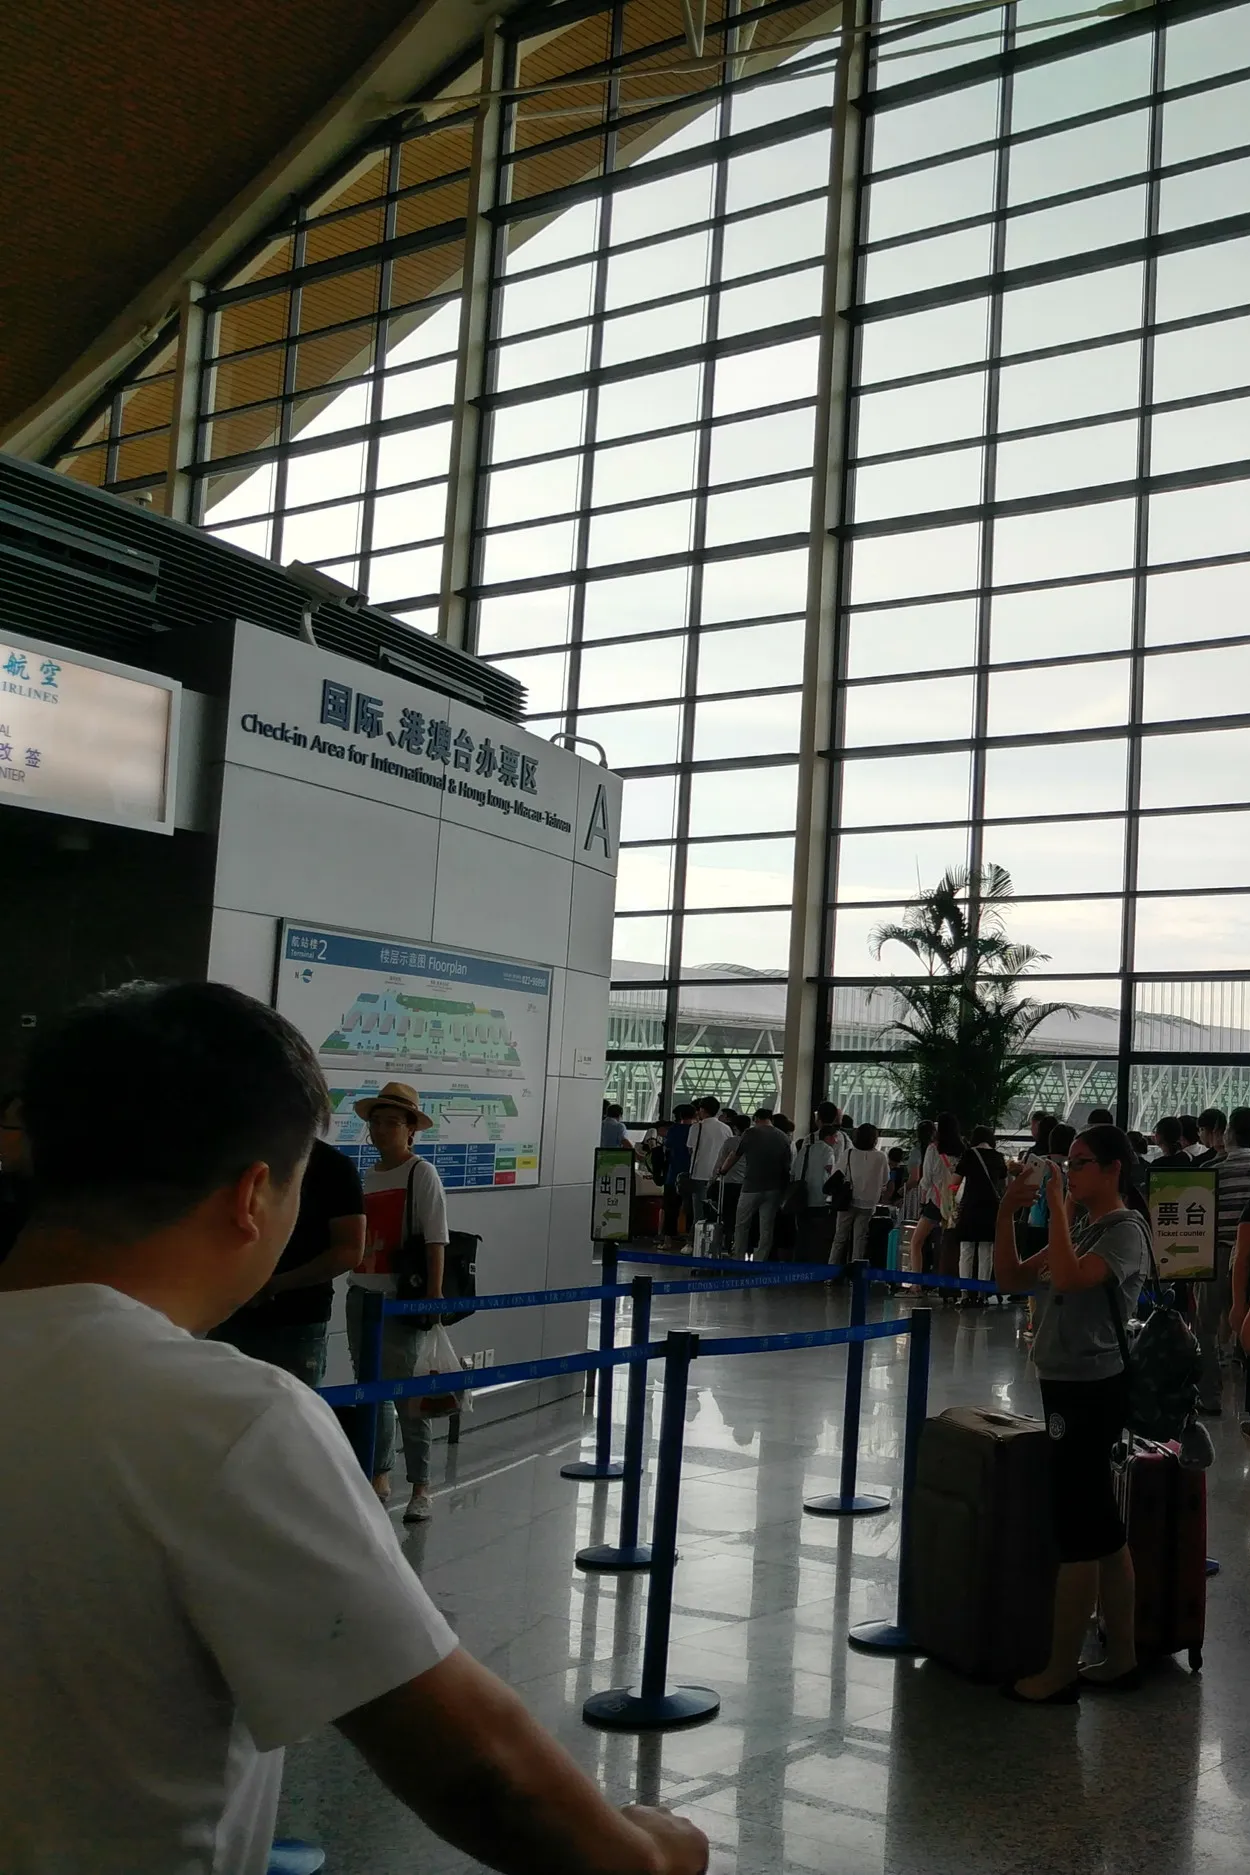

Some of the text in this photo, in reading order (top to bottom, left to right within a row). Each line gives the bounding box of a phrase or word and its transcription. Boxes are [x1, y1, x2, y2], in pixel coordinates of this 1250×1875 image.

[3, 652, 62, 688] 航空
[320, 679, 539, 795] 国际、港澳台办票区
[241, 713, 307, 748] Check-in
[310, 735, 345, 759] Area
[347, 744, 369, 766] for
[371, 753, 446, 791] International
[448, 779, 457, 794] &
[458, 780, 486, 807] Hong
[584, 784, 612, 858] A
[290, 949, 315, 959] Terminal
[291, 935, 328, 960] 航站楼 2
[294, 971, 300, 979] N
[380, 948, 468, 976] 楼层示意图 Floorplan
[600, 1173, 626, 1195] 出口
[1157, 1202, 1206, 1226] 票台
